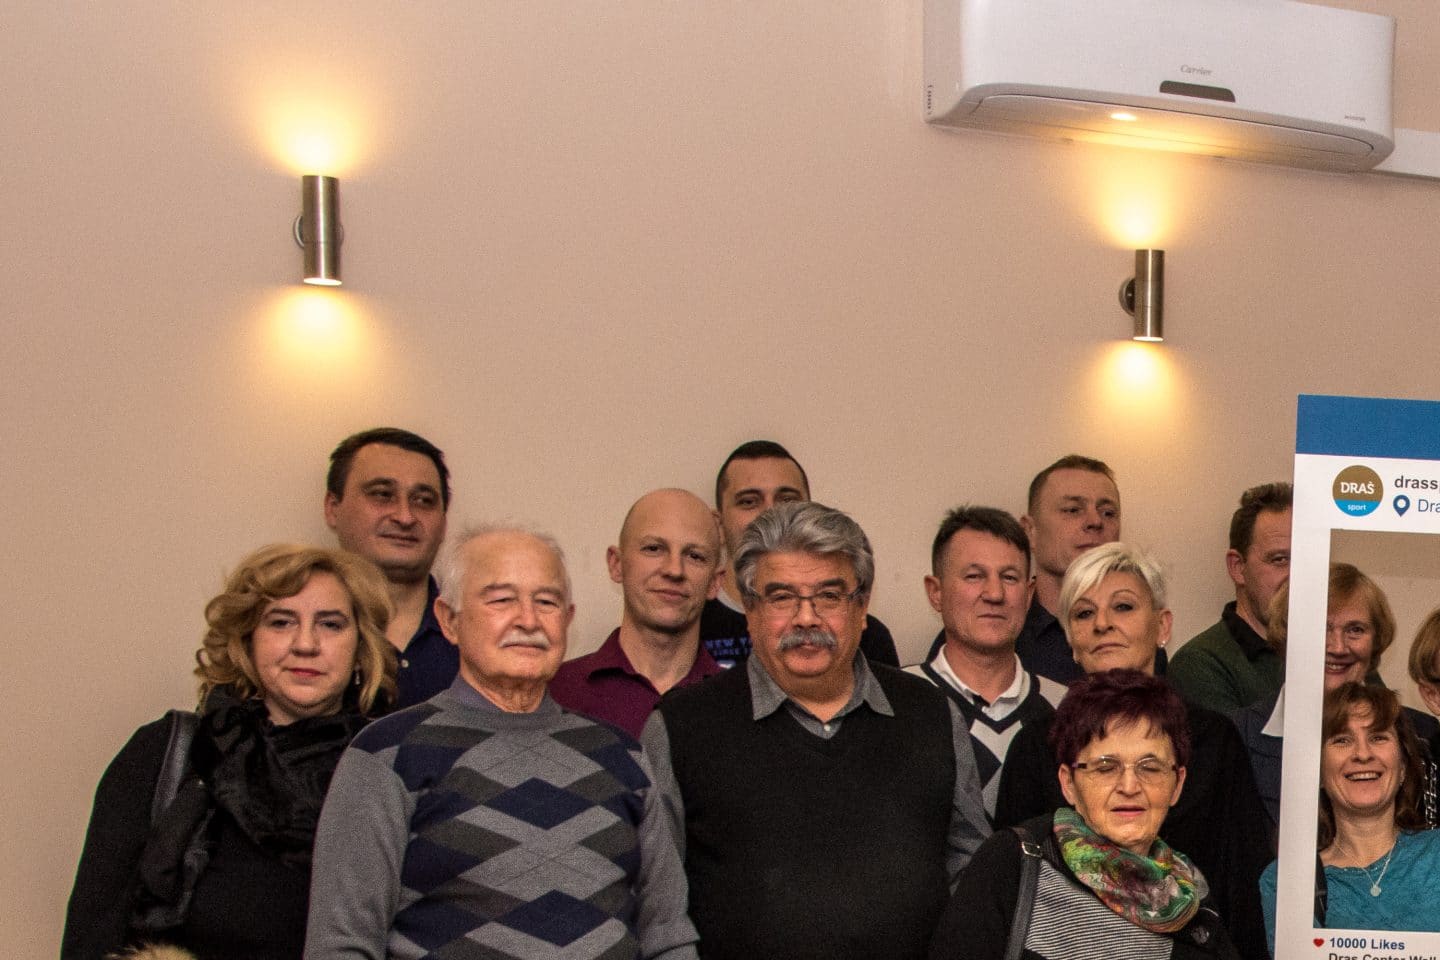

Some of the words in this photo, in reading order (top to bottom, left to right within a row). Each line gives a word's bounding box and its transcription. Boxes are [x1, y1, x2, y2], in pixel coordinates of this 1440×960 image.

[1340, 481, 1375, 495] DRAŠ
[1347, 503, 1367, 512] sport
[1329, 938, 1367, 949] 10000
[1371, 939, 1405, 950] Likes
